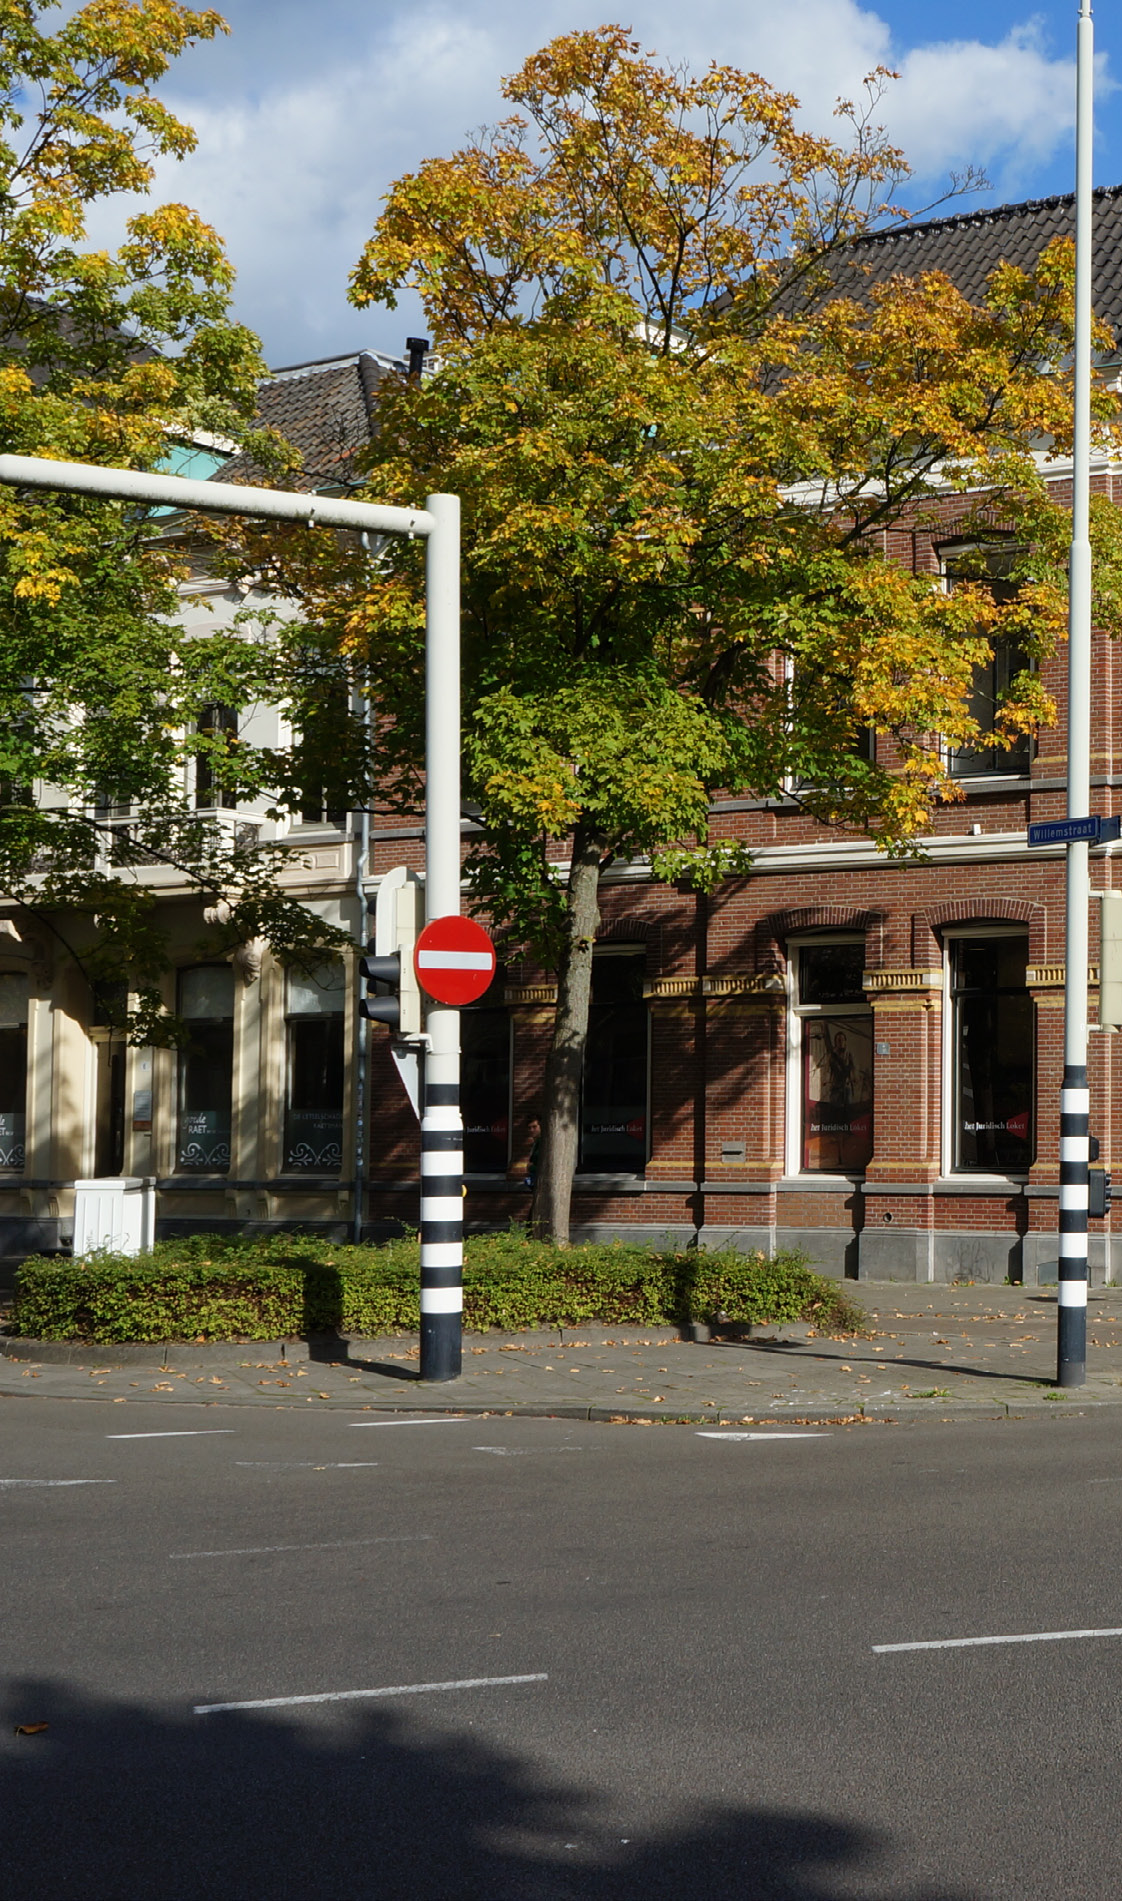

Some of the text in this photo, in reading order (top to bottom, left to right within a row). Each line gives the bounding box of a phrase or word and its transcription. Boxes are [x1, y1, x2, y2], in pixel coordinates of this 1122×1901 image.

[1033, 823, 1092, 841] Willemstraat
[821, 1123, 849, 1132] Juridisch
[975, 1121, 1005, 1132] Juridisch
[1006, 1121, 1025, 1130] Loket
